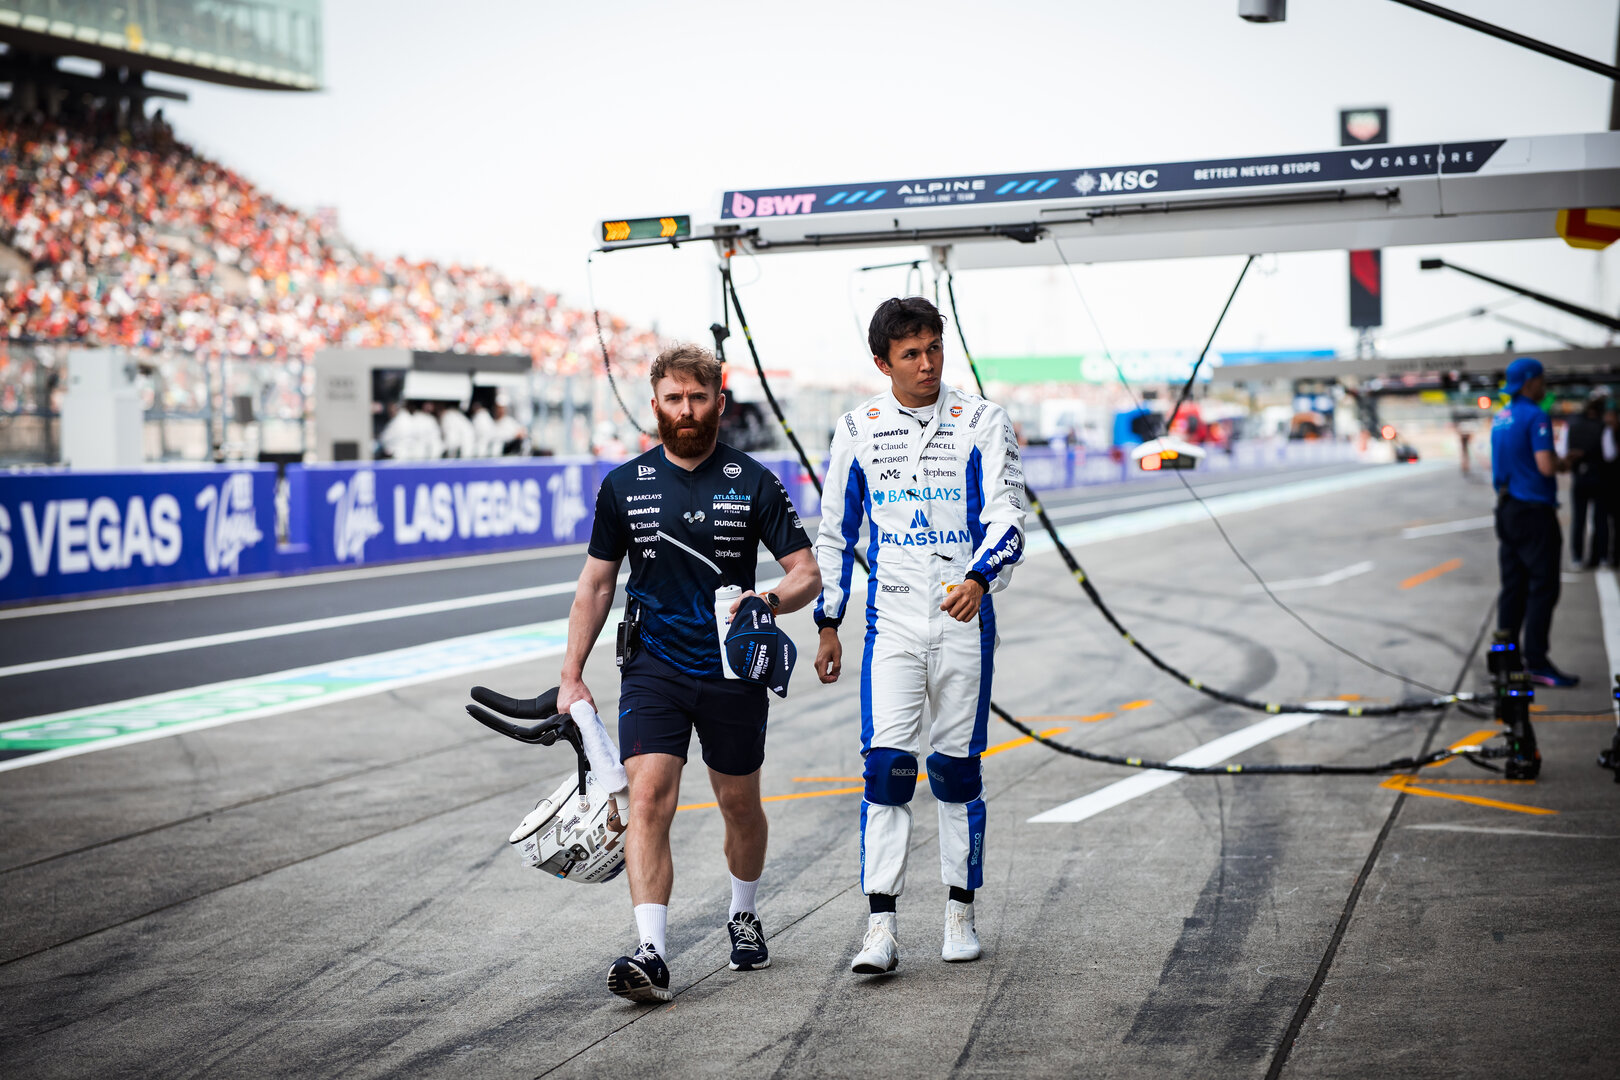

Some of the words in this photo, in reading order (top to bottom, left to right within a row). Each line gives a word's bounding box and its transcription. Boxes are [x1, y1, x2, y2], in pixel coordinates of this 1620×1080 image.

[1380, 151, 1474, 168] CASTORE
[1194, 166, 1238, 181] BETTER
[1240, 164, 1279, 178] NEVER
[1282, 161, 1321, 175] STOPS
[896, 179, 986, 196] ALPINE
[1098, 169, 1159, 192] MSC
[755, 193, 817, 217] BWT
[968, 403, 988, 429] sparco
[873, 428, 909, 438] KOMATSU
[880, 441, 908, 451] Claude
[879, 455, 909, 464] kraken
[922, 467, 957, 478] Stephens
[633, 493, 663, 502] BARCLAYS
[888, 487, 961, 503] BARCLAYS
[393, 481, 454, 544] LAS
[454, 477, 543, 539] VEGAS
[627, 506, 661, 516] KOMATSU
[712, 502, 751, 511] Williams
[635, 520, 660, 530] Claude
[19, 493, 183, 577] VEGAS
[880, 530, 971, 546] ATLASSIAN
[881, 584, 910, 594] sparco
[751, 644, 768, 680] Williams
[891, 768, 916, 776] sparco
[970, 833, 982, 866] sparco
